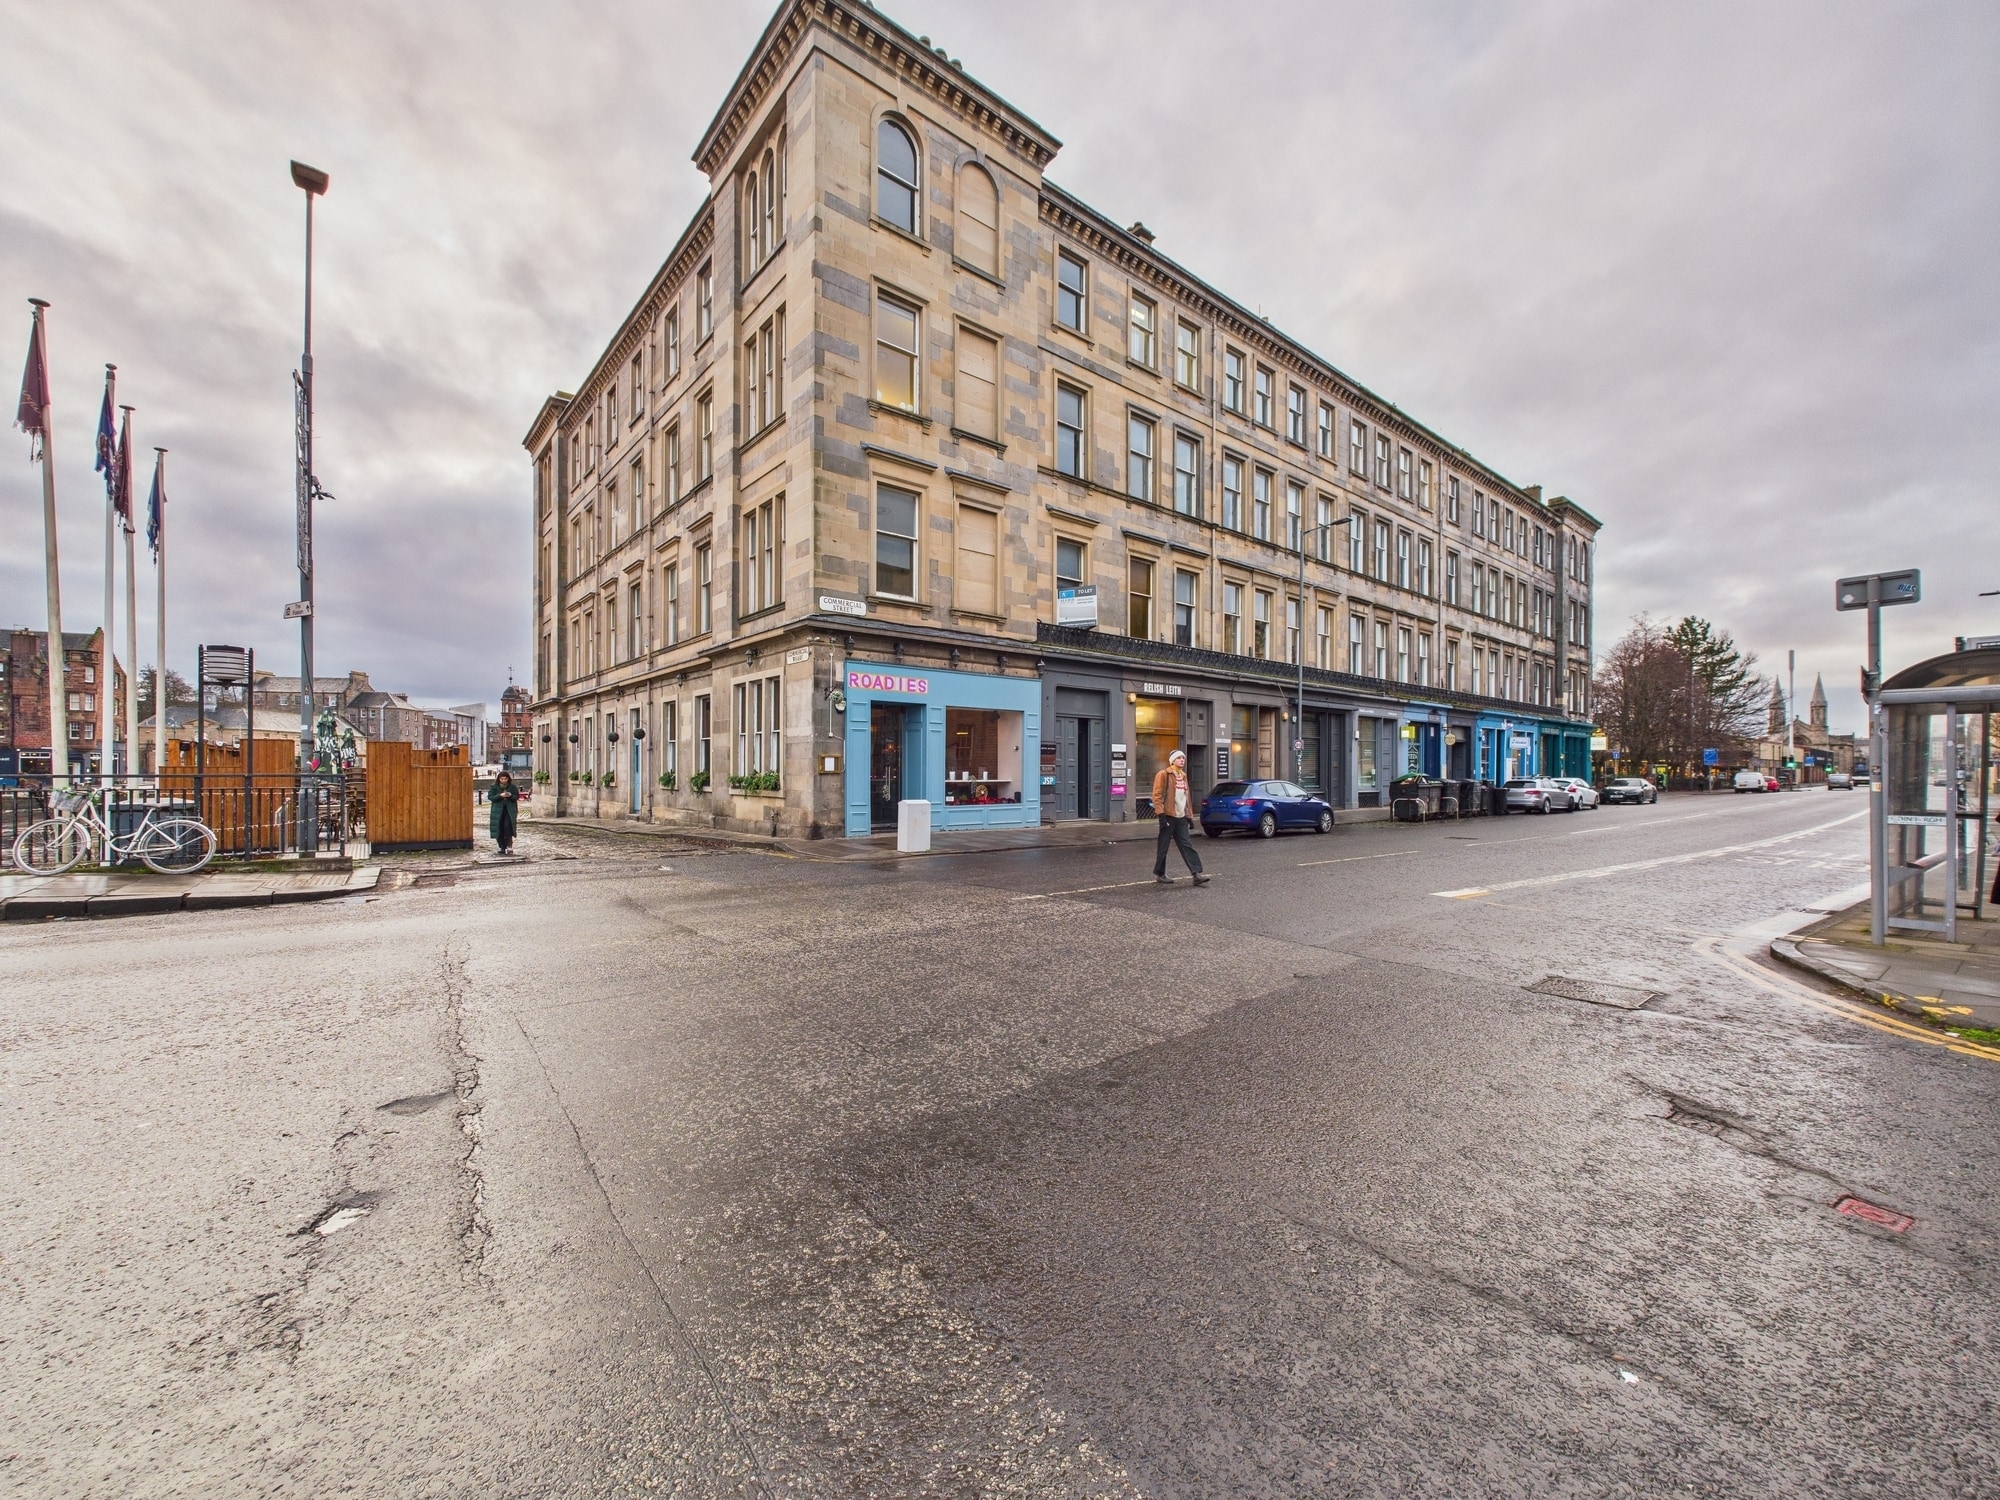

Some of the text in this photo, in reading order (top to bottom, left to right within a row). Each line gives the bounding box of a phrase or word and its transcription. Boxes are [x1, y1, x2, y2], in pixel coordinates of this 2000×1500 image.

[823, 598, 862, 609] COMMERCIAL
[833, 605, 854, 613] STREET
[849, 672, 927, 693] ROADIES
[1144, 682, 1182, 696] RELISH LEITH
[1042, 777, 1054, 785] JSP
